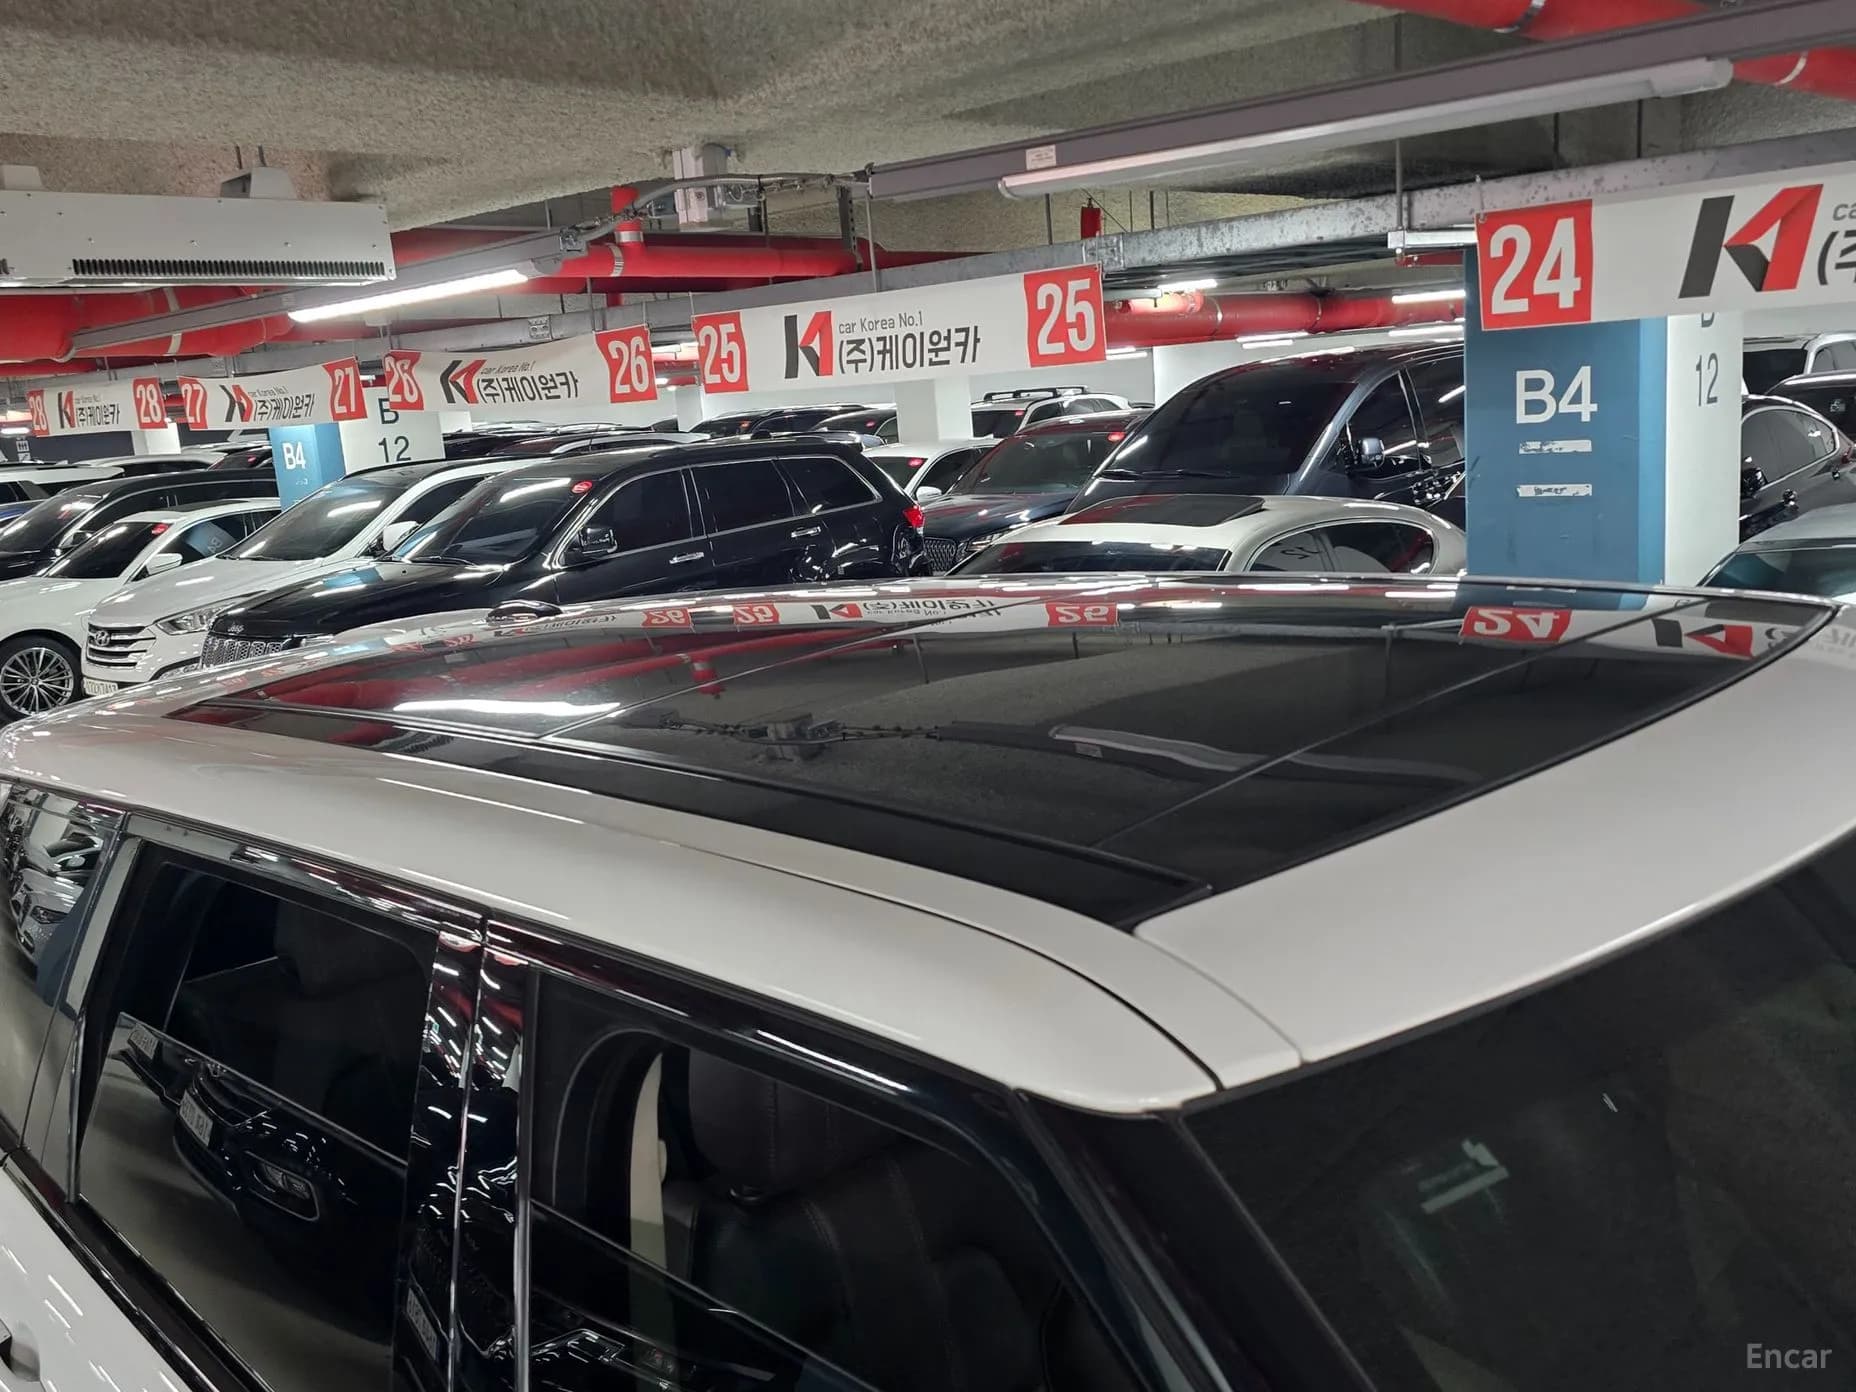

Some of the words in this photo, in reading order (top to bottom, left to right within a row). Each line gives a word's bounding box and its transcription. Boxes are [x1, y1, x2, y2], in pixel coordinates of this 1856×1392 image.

[1490, 217, 1582, 315] 24
[839, 322, 856, 334] car
[860, 316, 895, 333] Korea
[899, 310, 924, 329] No.1
[1036, 278, 1097, 355] 25
[608, 335, 649, 395] 26
[699, 323, 740, 384] 25
[838, 325, 981, 375] (주)케이원카
[136, 383, 161, 423] 28
[181, 383, 203, 423] 27
[334, 366, 356, 414] 27
[384, 355, 418, 403] 26
[477, 370, 579, 404] (주)케이원카
[1516, 365, 1598, 424] B4
[1696, 352, 1719, 407] 12
[29, 395, 47, 430] 28
[253, 393, 315, 421] (주)케이원카
[282, 441, 306, 469] B4
[378, 435, 411, 463] 12
